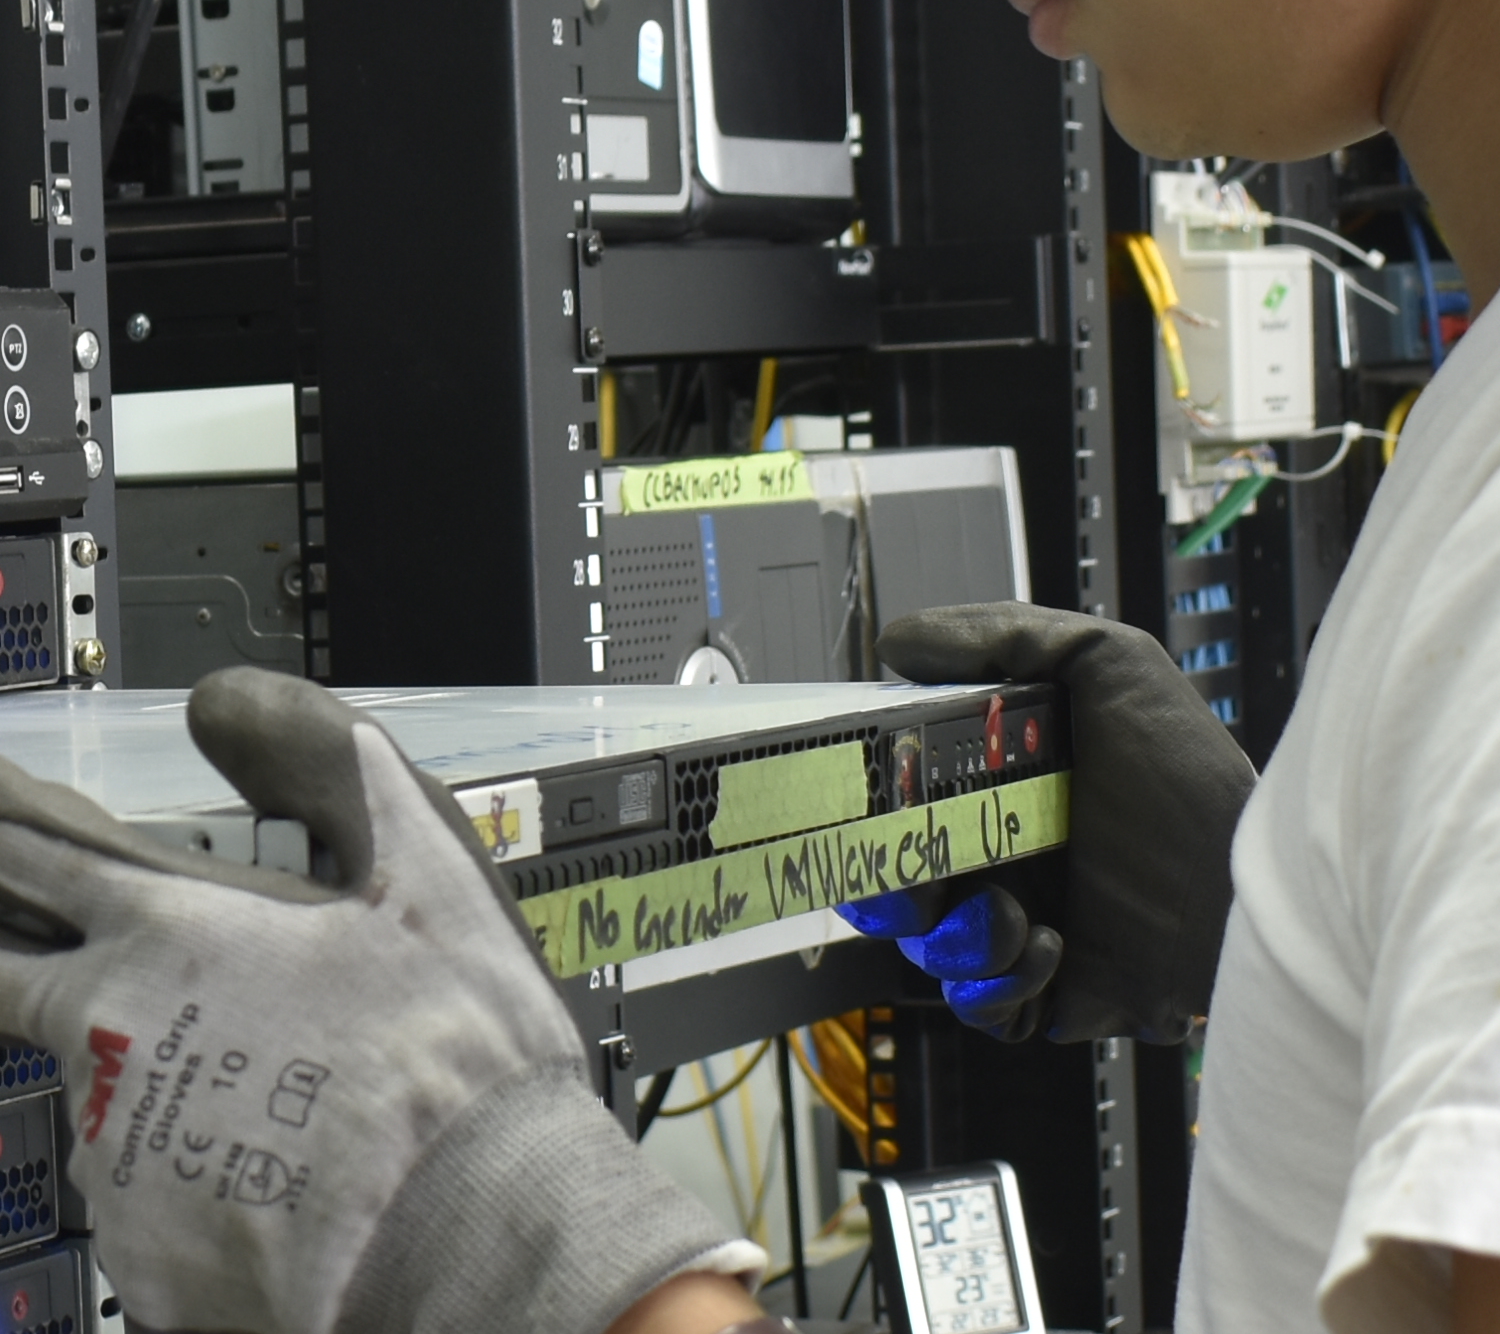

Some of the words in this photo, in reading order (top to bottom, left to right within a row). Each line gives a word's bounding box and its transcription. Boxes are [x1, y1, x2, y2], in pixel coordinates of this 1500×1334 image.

[578, 887, 619, 964] No
[79, 1024, 134, 1145] 3M
[112, 1070, 167, 1188] Comfort
[155, 1004, 200, 1062] Grip
[148, 1053, 203, 1152] Gloves
[211, 1050, 249, 1090] 10
[914, 1196, 956, 1248] 32
